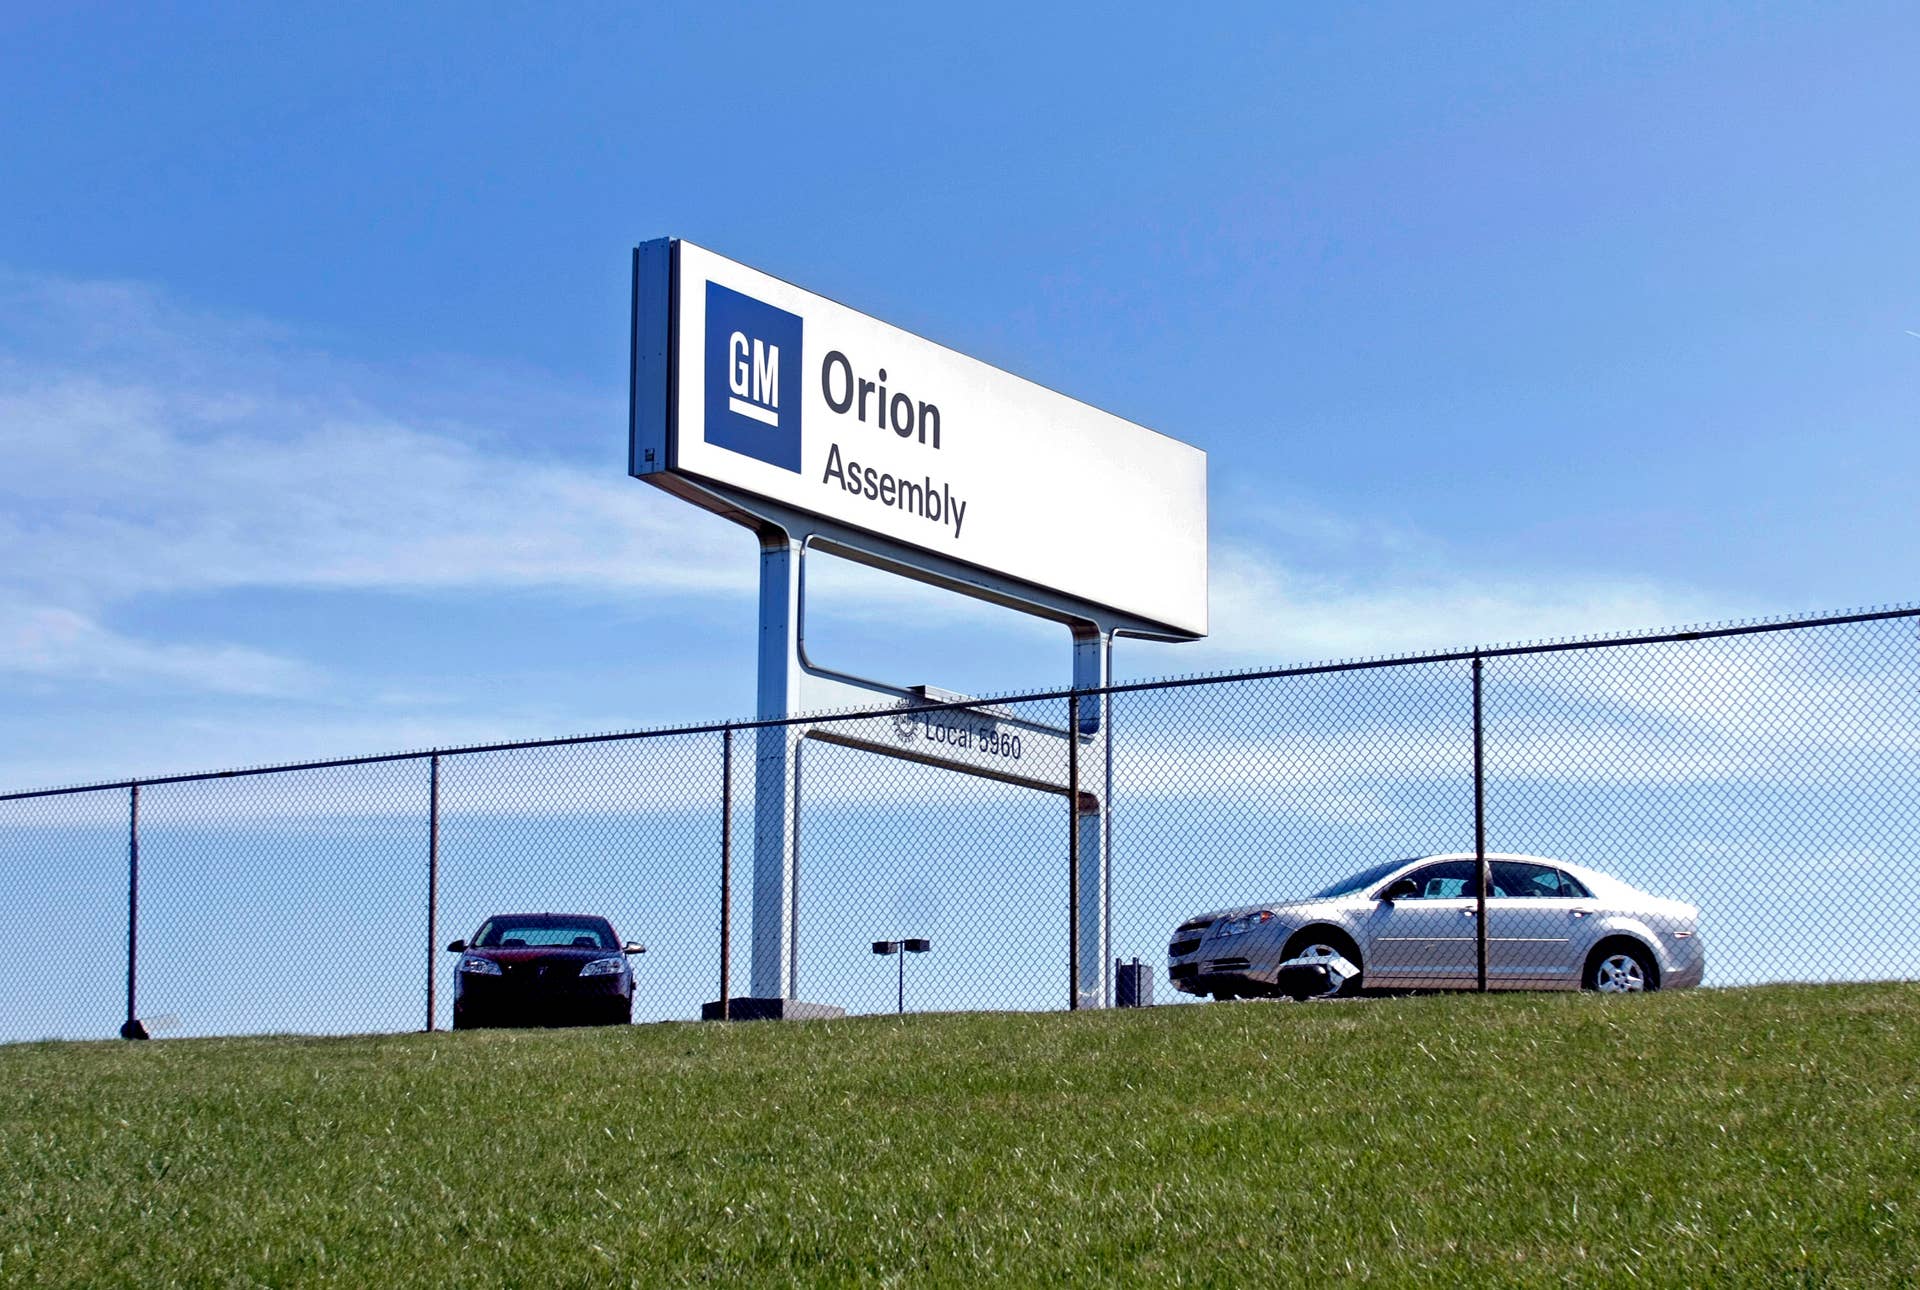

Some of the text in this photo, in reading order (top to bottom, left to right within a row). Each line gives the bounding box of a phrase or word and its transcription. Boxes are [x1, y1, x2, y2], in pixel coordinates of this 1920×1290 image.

[729, 331, 779, 408] GM
[821, 350, 941, 449] Orion
[823, 443, 966, 538] Assembly
[926, 714, 972, 749] Local
[979, 728, 1021, 760] 5960
